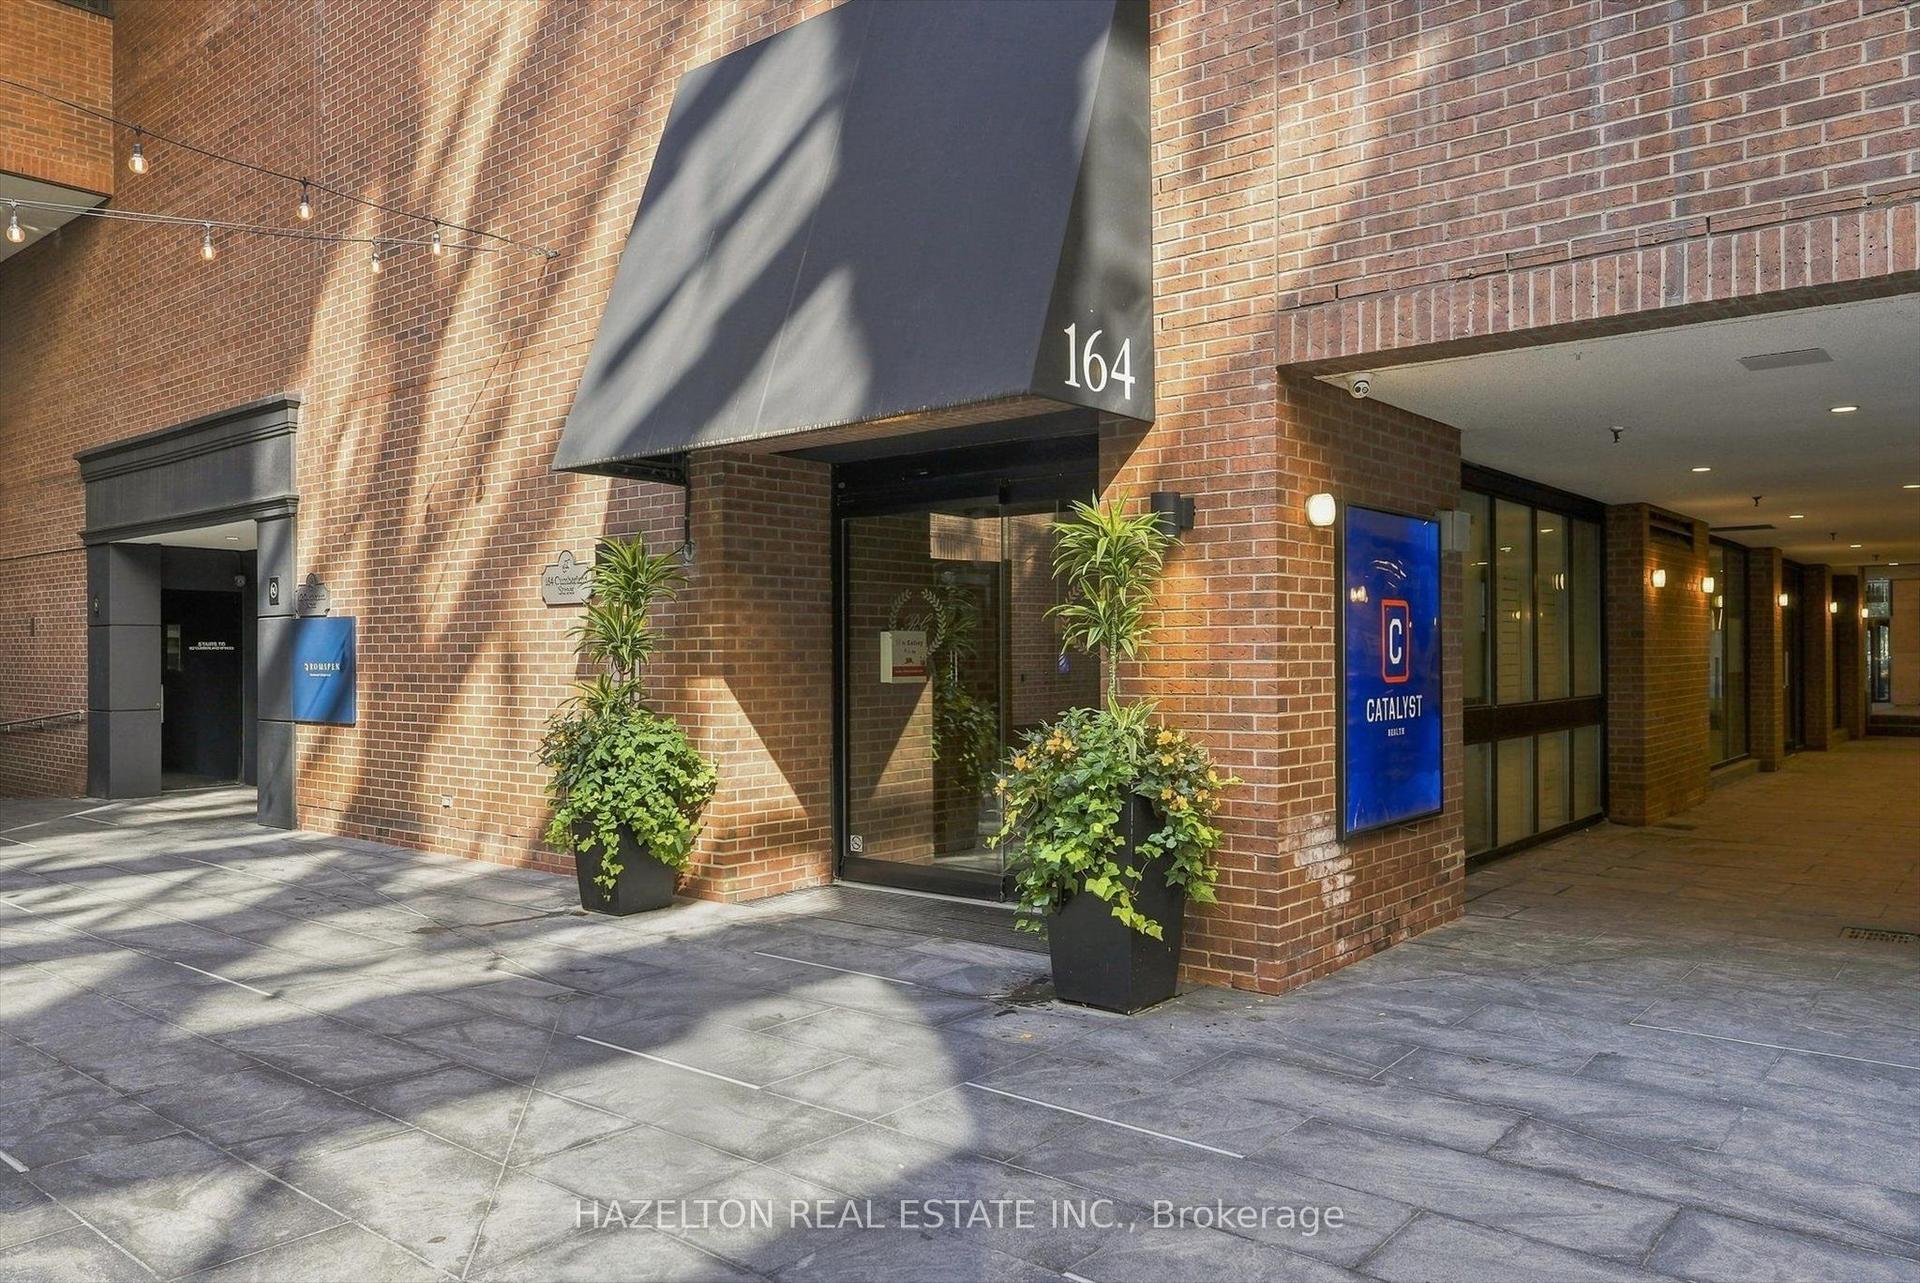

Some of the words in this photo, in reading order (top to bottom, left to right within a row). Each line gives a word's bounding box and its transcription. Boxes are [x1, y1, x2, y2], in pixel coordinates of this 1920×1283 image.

[1063, 322, 1136, 400] 164
[1390, 618, 1401, 664] C
[1367, 695, 1423, 722] CATALYST
